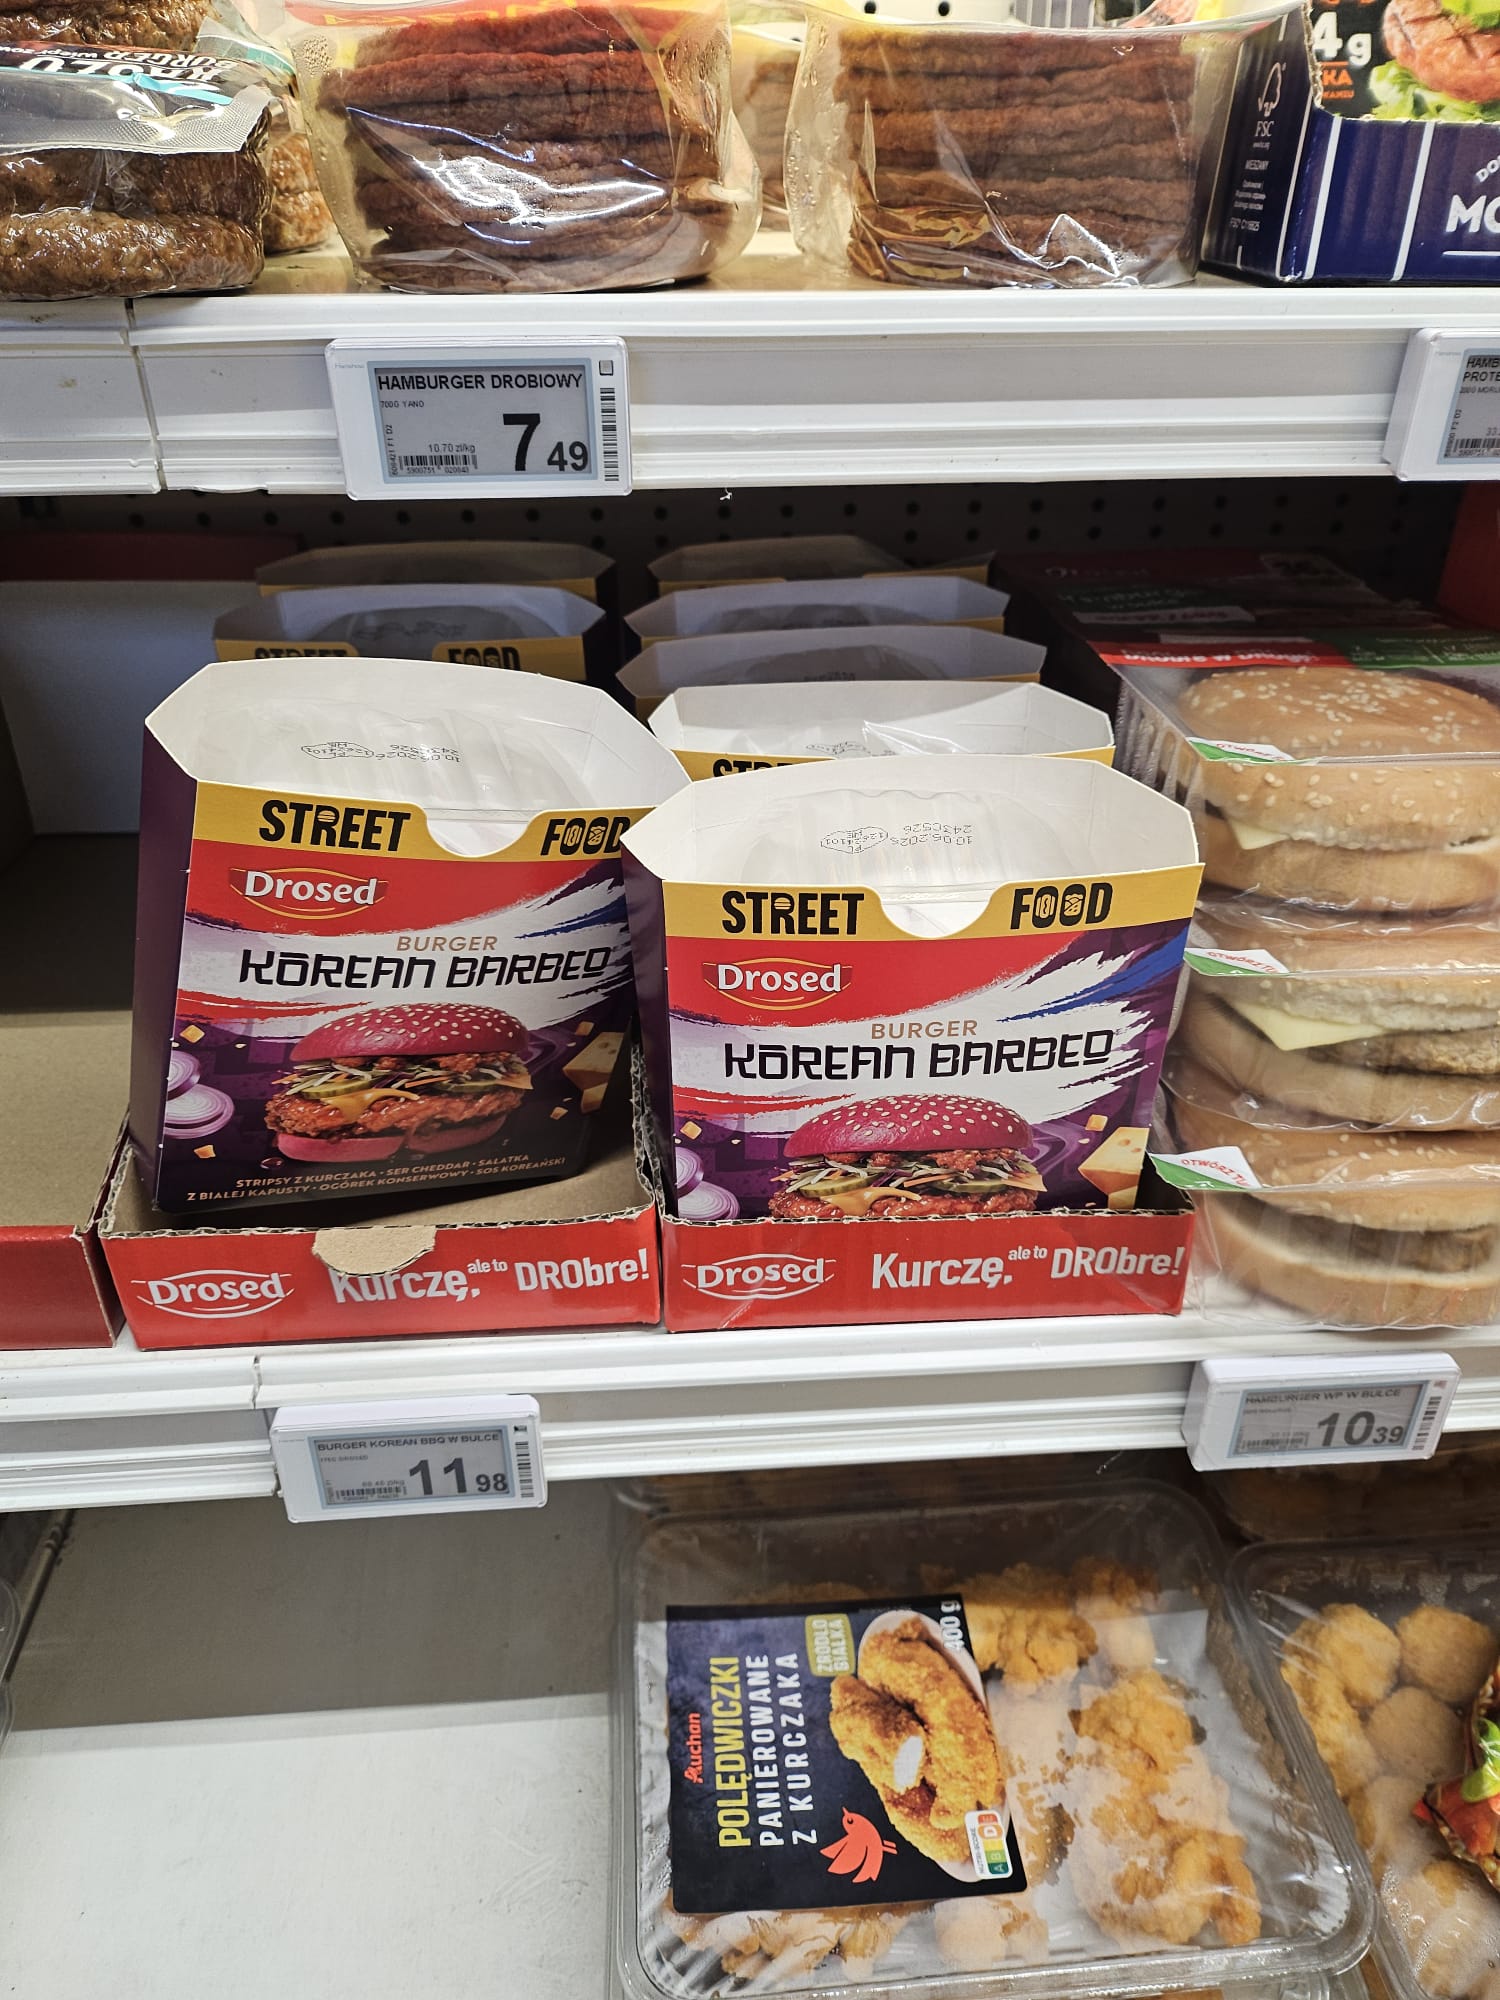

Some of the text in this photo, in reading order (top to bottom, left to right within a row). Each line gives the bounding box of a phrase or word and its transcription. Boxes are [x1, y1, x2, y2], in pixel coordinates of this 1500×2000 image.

[1346, 33, 1372, 68] g
[1255, 120, 1275, 138] FSC
[378, 374, 582, 390] HAMBURGER DROBIOWY
[503, 413, 588, 472] 7 49
[259, 799, 631, 856] STREET FOOD
[245, 870, 377, 906] Drosed
[721, 881, 1114, 936] STREET FOOD
[396, 935, 498, 952] BURGER
[717, 961, 843, 994] Drosed
[871, 1019, 978, 1039] BURGER
[187, 1191, 197, 1201] Z
[248, 1184, 310, 1199] KAPUSTY
[377, 1170, 468, 1187] KONSERWOWY
[475, 1165, 500, 1178] SOS
[236, 1177, 292, 1189] STRIPSY
[293, 1175, 302, 1186] Z
[305, 1170, 378, 1184] KURCZAKA
[386, 1164, 411, 1175] SER
[411, 1160, 472, 1174] CHEDDAR
[148, 1272, 286, 1307] Drosed
[466, 1258, 492, 1275] ale
[491, 1257, 508, 1273] to
[514, 1248, 650, 1293] DRObre!
[698, 1244, 1185, 1289] Drosed Kurczę, ale to DRObre!
[317, 1441, 367, 1451] BURGER
[370, 1438, 418, 1448] KOREAN
[447, 1435, 459, 1444] W
[460, 1433, 499, 1442] BULCE
[1317, 1411, 1404, 1447] 10 39
[408, 1457, 508, 1496] 11 98
[940, 1615, 965, 1651] 400
[684, 1712, 705, 1784] Auchan
[708, 1656, 752, 1848] POLĘDWICZKI
[745, 1654, 784, 1848] PANIEROWANE
[776, 1652, 818, 1845] Z KURCZAKA
[983, 1826, 997, 1837] D
